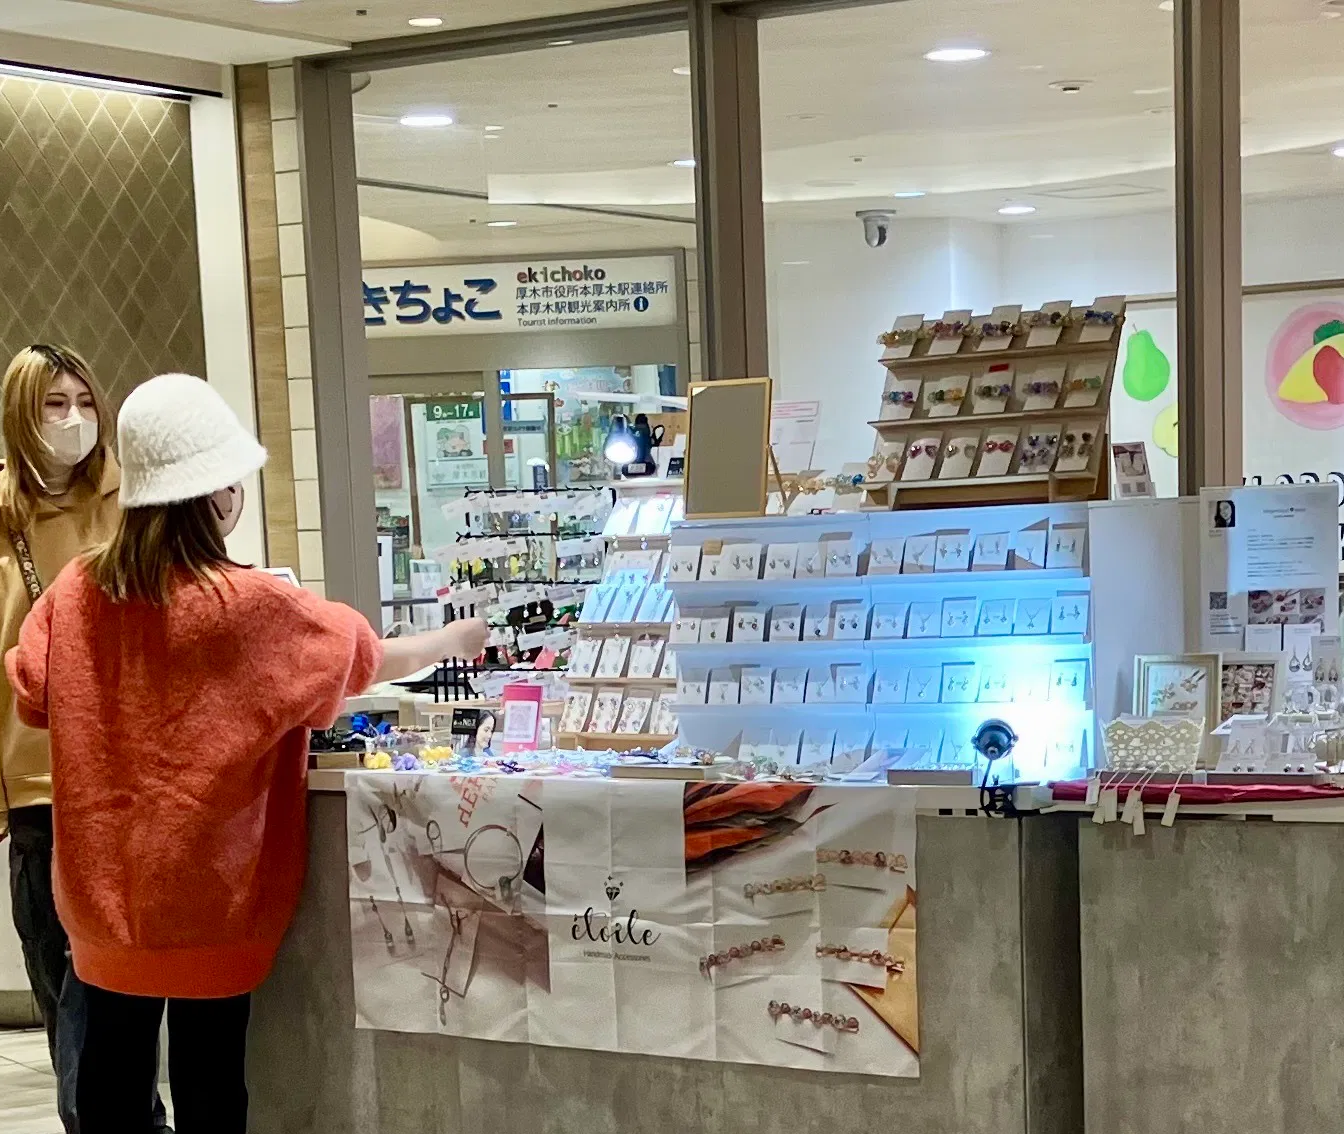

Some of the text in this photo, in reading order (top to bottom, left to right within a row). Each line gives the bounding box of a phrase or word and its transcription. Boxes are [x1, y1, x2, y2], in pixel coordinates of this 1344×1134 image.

[516, 265, 606, 284] ekichoko
[515, 280, 669, 300] 厚木市役所本厚木駅連絡所
[517, 317, 547, 327] Tourist
